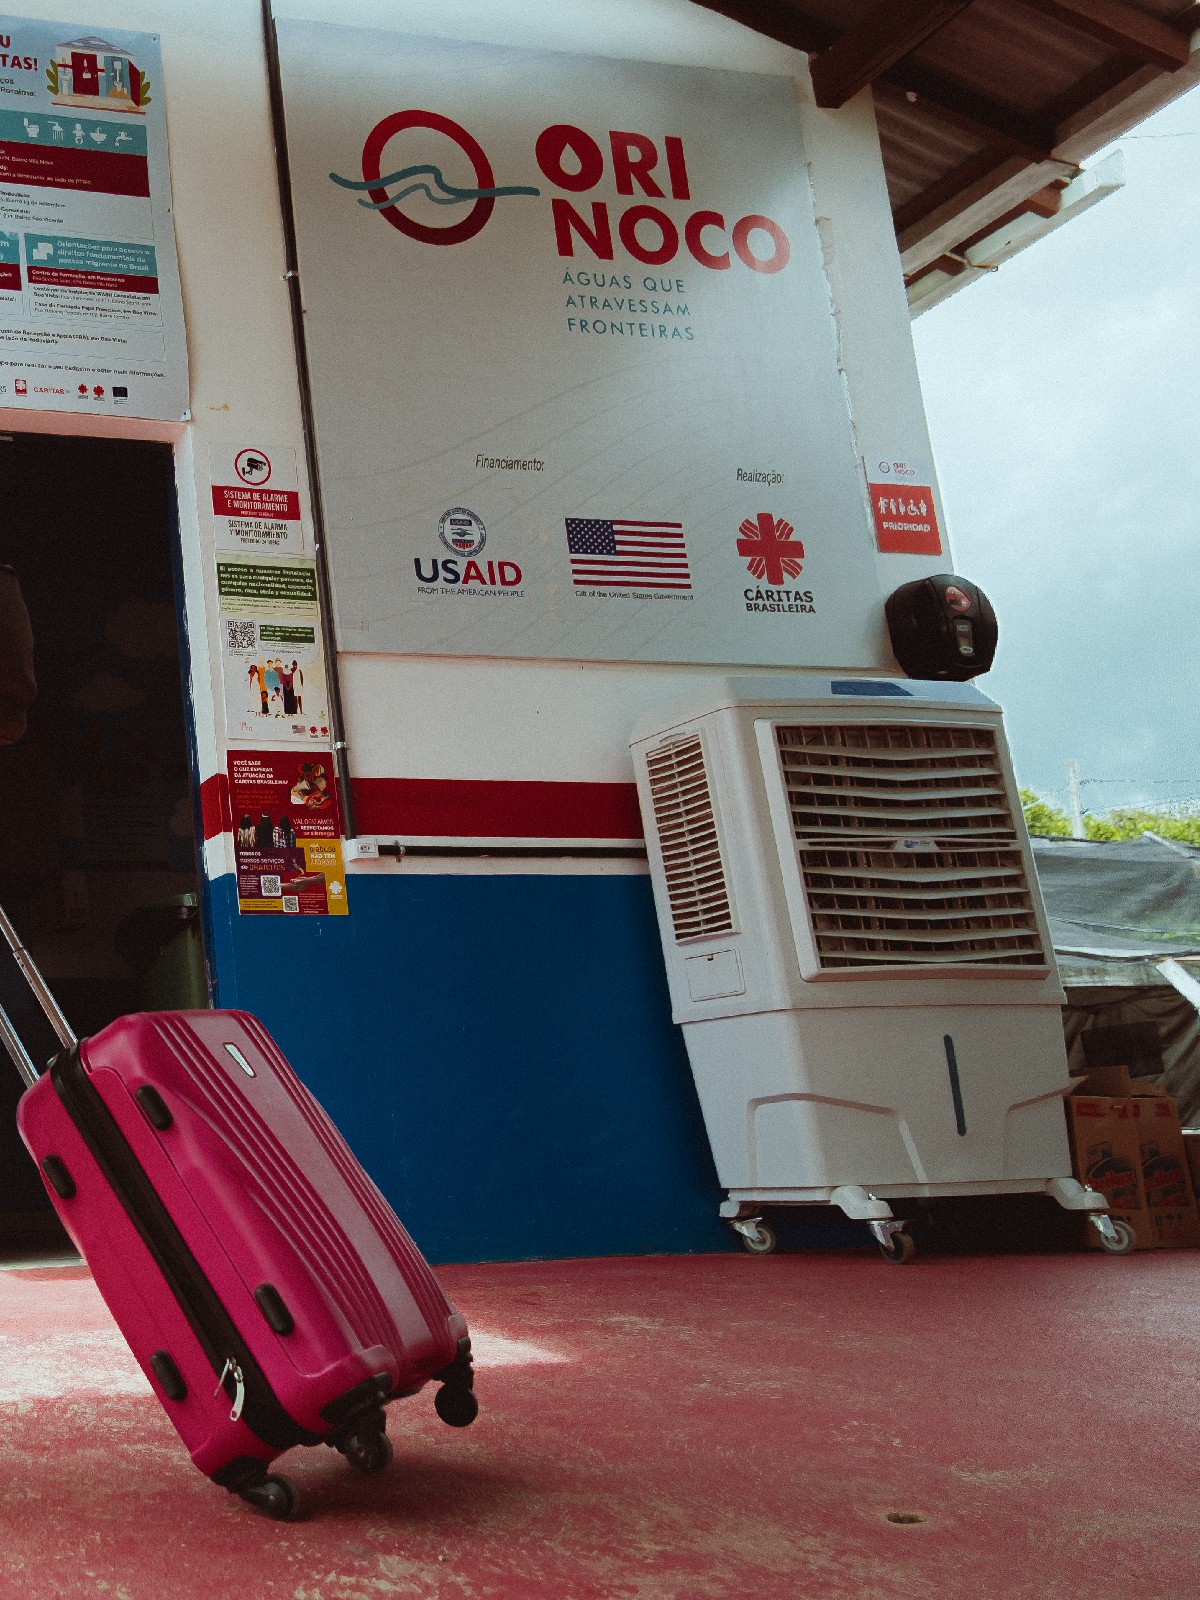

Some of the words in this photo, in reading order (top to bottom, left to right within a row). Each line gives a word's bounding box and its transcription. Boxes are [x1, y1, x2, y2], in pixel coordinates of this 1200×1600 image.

[535, 124, 691, 200] ORI
[551, 197, 791, 275] NOCO
[129, 262, 150, 271] Brasil
[563, 266, 632, 291] ÁGUAS
[642, 276, 685, 294] QUE
[565, 294, 692, 317] ATRAVESSAM
[567, 317, 696, 342] FRONTEIRAS
[475, 453, 545, 472] Financiamento:
[736, 468, 785, 486] Realização:
[223, 489, 252, 500] SISTEMA
[252, 492, 261, 501] DE
[262, 493, 289, 503] ALARME
[227, 499, 232, 508] E
[233, 500, 288, 512] MONITORAMENTO
[228, 519, 253, 529] SISTEMA
[254, 521, 262, 530] DE
[263, 522, 288, 531] ALARMA
[882, 521, 931, 532] PRIORIDAD
[229, 528, 234, 536] Y
[235, 529, 288, 540] MONITORAMIENTO
[413, 557, 523, 587] USAID
[417, 586, 439, 595] FROM
[440, 587, 456, 595] THE
[456, 587, 497, 597] AMERICAN
[497, 589, 525, 598] PEOPLE
[608, 591, 631, 599] United
[632, 592, 653, 600] States
[743, 585, 814, 603] CÁRITAS
[745, 602, 817, 614] BRASILEIRA
